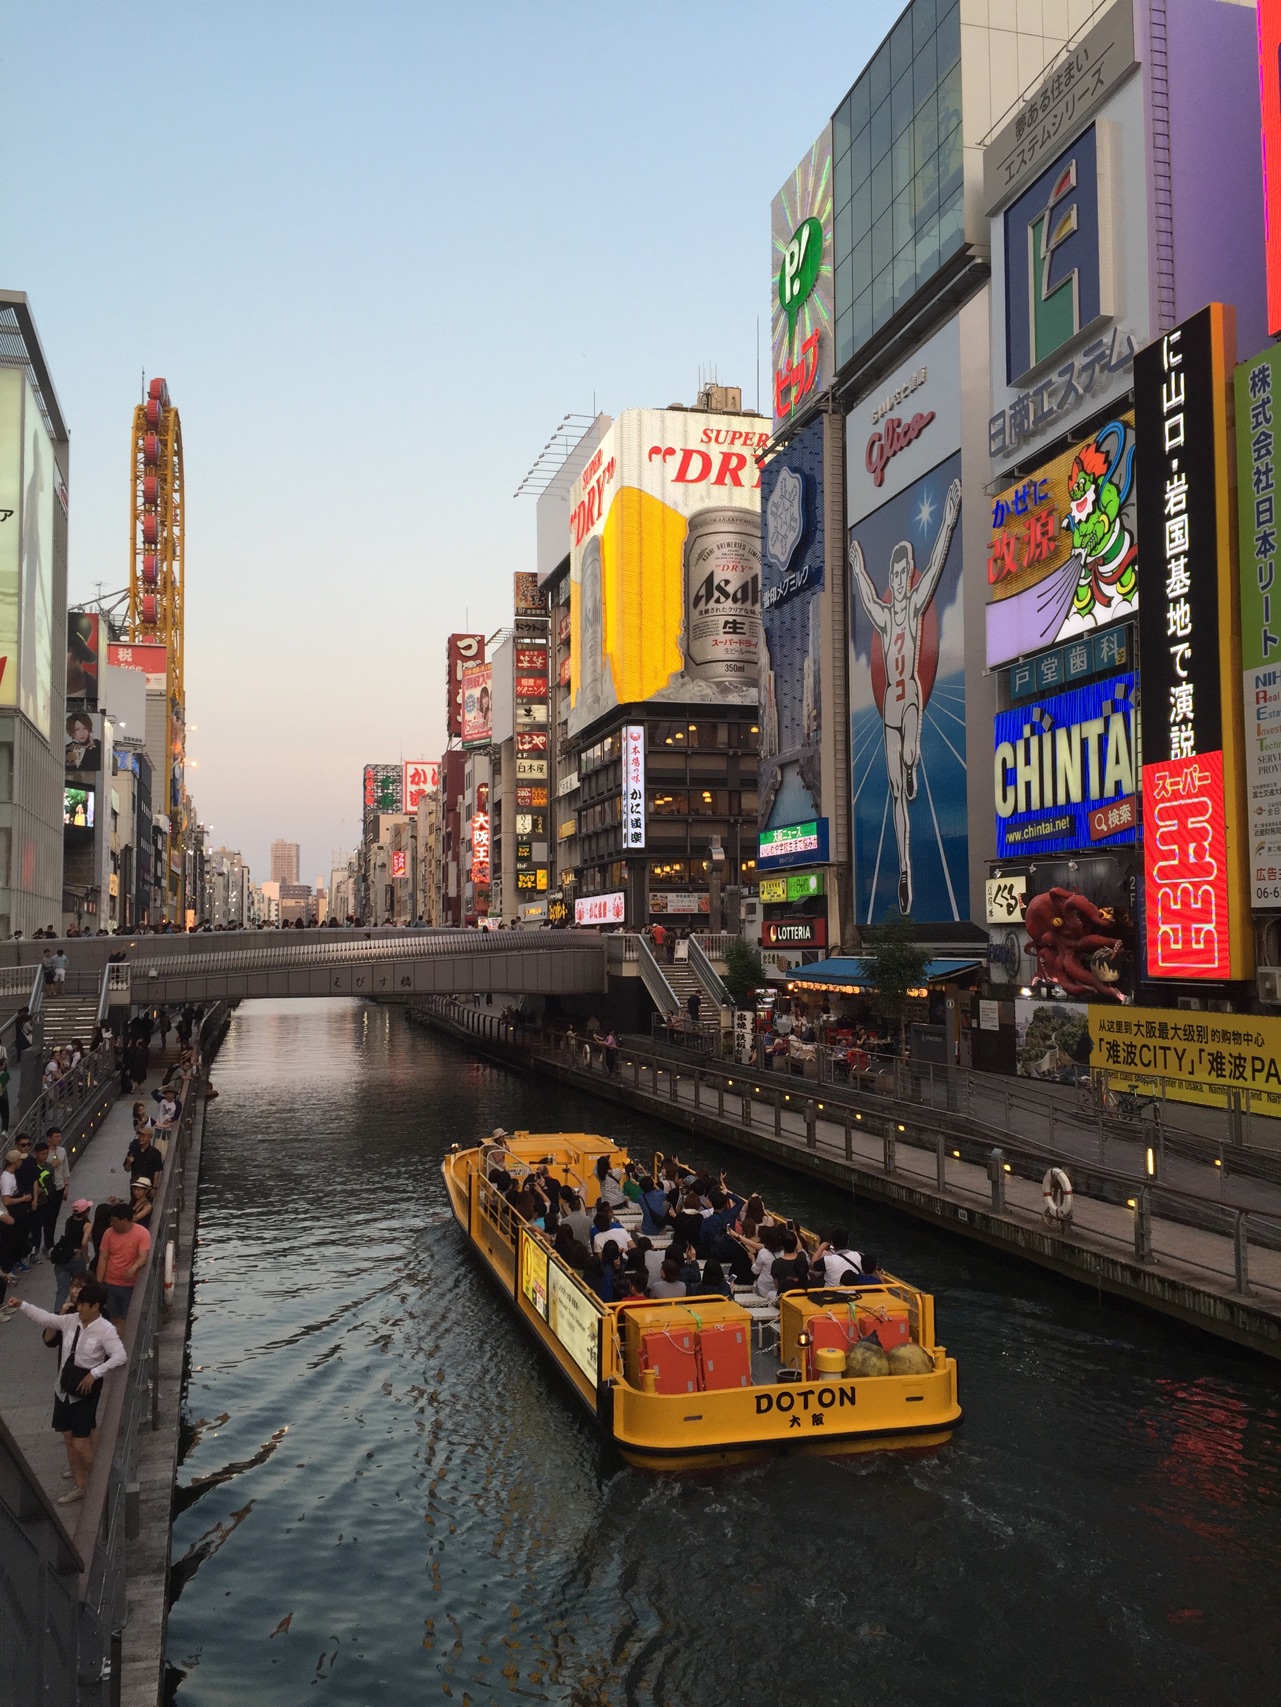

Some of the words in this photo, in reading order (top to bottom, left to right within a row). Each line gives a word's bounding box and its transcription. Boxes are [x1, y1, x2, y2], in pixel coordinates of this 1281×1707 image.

[1014, 48, 1089, 142] 夢ある住まい
[1004, 61, 1105, 186] エステムシリーズ
[774, 327, 821, 418] ピップ
[989, 326, 1139, 457] 日商エステム
[700, 427, 770, 448] SUPER
[865, 411, 937, 487] Glico
[991, 477, 1049, 528] かぜに
[1249, 362, 1280, 658] 株式会社日本リート
[987, 506, 1056, 585] 改源
[763, 565, 809, 609] 雪印メグミルク
[722, 619, 747, 635] 生
[724, 663, 745, 673] 350ml
[893, 626, 907, 703] グリコ
[1014, 632, 1120, 693] 戸堂歯科
[1256, 706, 1281, 721] Esta
[1153, 764, 1211, 799] スーパー
[1108, 804, 1132, 828] 検索
[1256, 885, 1281, 900] 06-6
[777, 925, 811, 940] LOTTERIA
[754, 1385, 856, 1414] DOTON
[789, 1412, 825, 1429] 大阪
